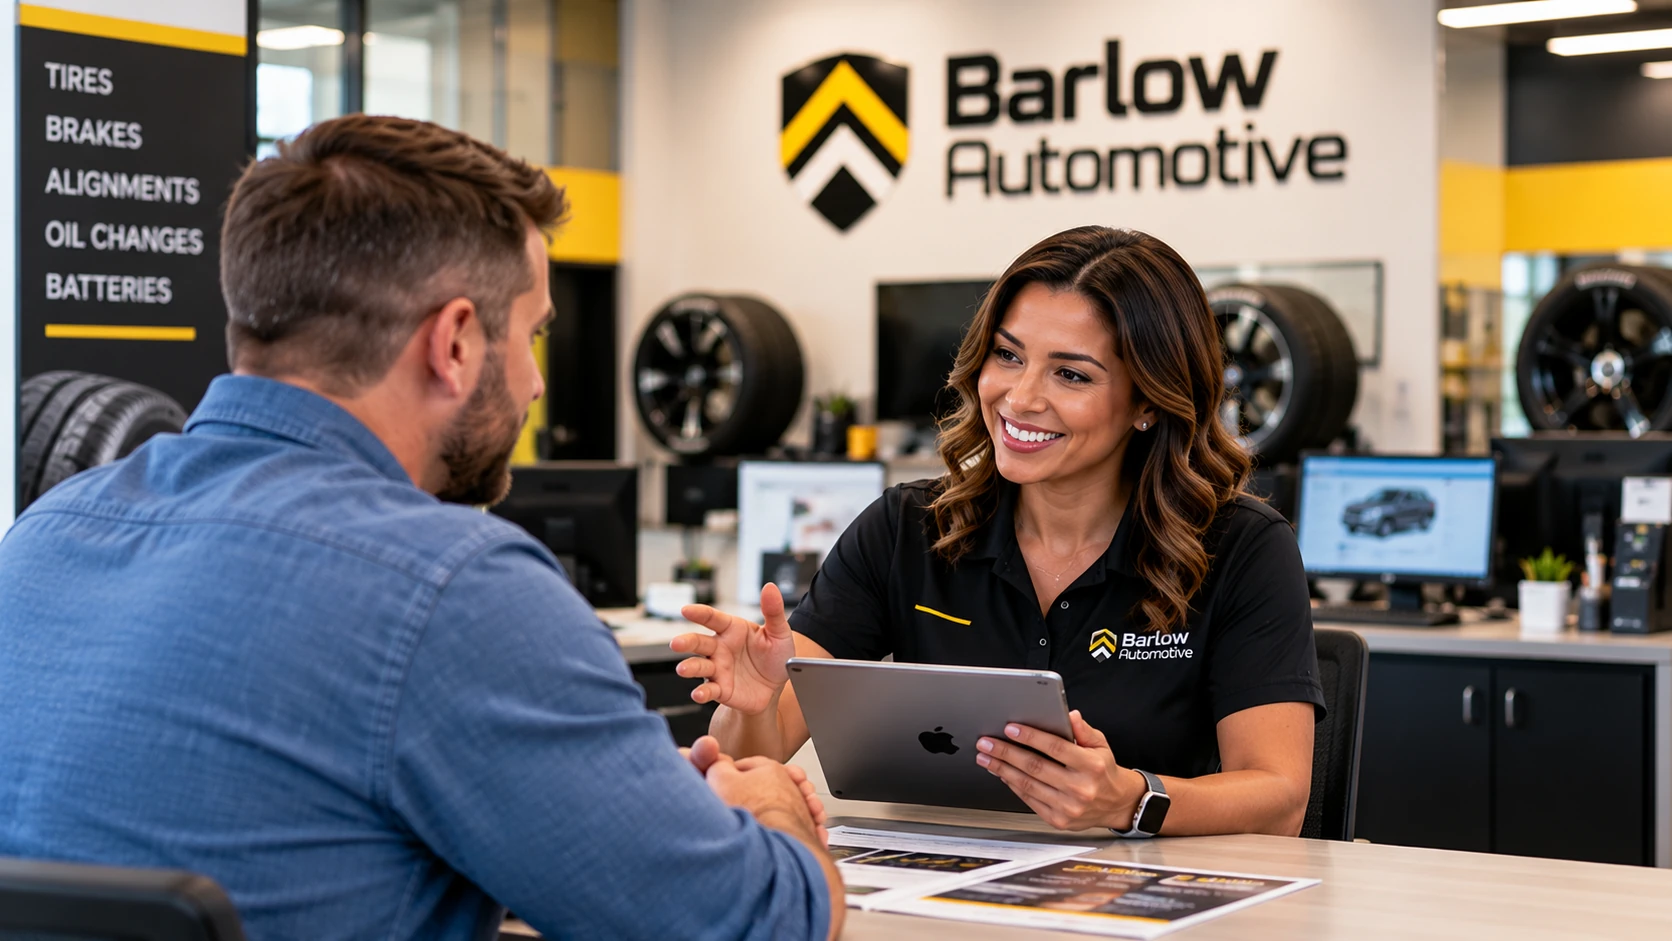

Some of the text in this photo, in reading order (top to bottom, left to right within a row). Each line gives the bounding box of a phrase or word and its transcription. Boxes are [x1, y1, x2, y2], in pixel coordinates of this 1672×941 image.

[44, 61, 113, 95] TIRES
[946, 39, 1278, 128] Barlow
[45, 115, 142, 149] BRAKES
[946, 122, 1348, 198] Automotive
[45, 168, 200, 204] ALIGNMENTS
[45, 220, 204, 255] OIL CHANGES
[45, 273, 172, 304] BATTERIES
[1118, 646, 1194, 660] Automotive
[1121, 630, 1190, 647] Barlow
